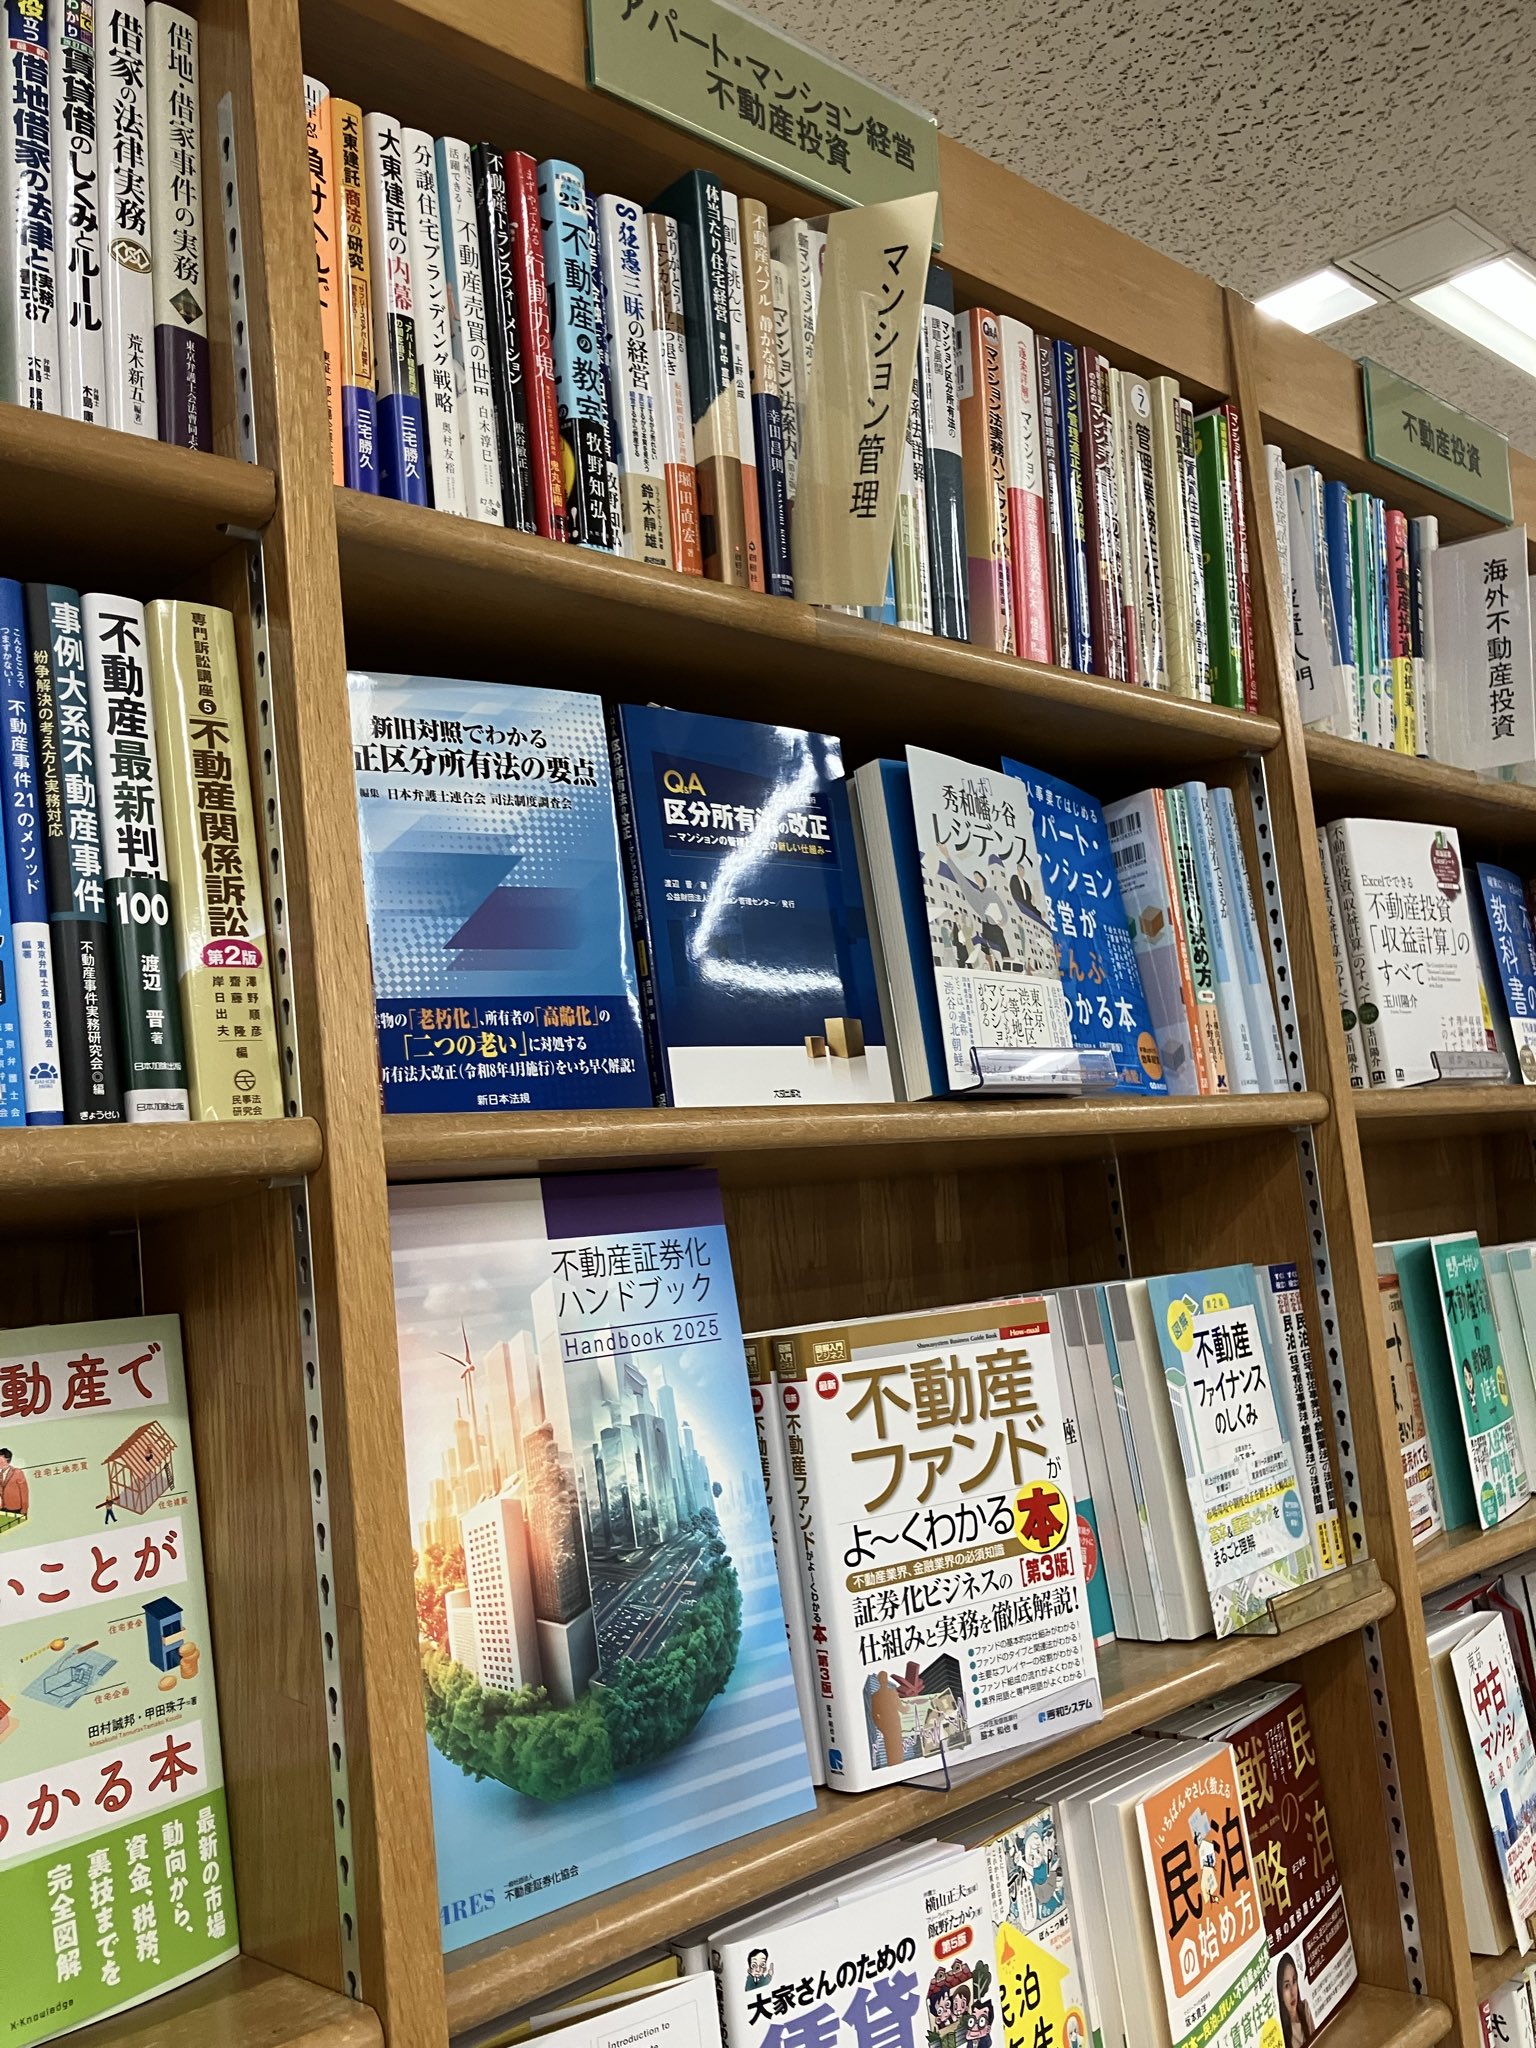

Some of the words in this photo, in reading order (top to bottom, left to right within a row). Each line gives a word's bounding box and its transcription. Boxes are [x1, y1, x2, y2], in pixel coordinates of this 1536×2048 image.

[108, 8, 147, 237] 借家の法律実務
[706, 70, 852, 174] 不動産投資
[12, 52, 56, 272] 借地借家の法律と
[167, 20, 200, 286] 借地・借家事件の実務
[62, 47, 102, 331] 賃貸借のしくみとルール
[378, 128, 412, 311] 大東建託の内幕
[25, 303, 50, 324] 87
[128, 333, 145, 403] 荒木新五
[850, 245, 909, 518] マンション管理
[357, 408, 374, 471] 三宅勝久
[402, 415, 420, 480] 三宅勝久
[1402, 410, 1483, 478] 不動産投資
[678, 471, 696, 544] 堀田直宏
[13, 628, 24, 689] こんなところで
[191, 612, 215, 698] 専門訴訟講座
[1482, 558, 1516, 741] 海外不動産投資
[33, 650, 64, 837] 紛争解決の考え方と実務対応
[50, 601, 106, 914] 事例大系不動産事件
[370, 715, 548, 749] 新旧対照でわかる
[355, 743, 598, 788] 正区分所有法の要点
[8, 699, 40, 896] 不動産事件21のメソッド
[359, 787, 380, 799] 編集
[387, 788, 487, 806] 日本弁護士連合会
[490, 793, 573, 810] 司法制度調査会
[189, 719, 250, 938] 不動産関係訴訟
[932, 812, 1034, 867] レジデンス
[116, 891, 169, 926] 100
[1360, 874, 1414, 889] Excelでできる
[1365, 892, 1452, 923] 不動産投資
[207, 945, 258, 966] 第2版
[1370, 925, 1470, 956] 「収益計算」の
[1490, 894, 1527, 1015] 教科書
[141, 954, 162, 992] 渡辺
[1378, 960, 1424, 986] すべて
[1383, 994, 1418, 1009] 玉川陽介
[145, 1009, 165, 1028] 晋
[150, 1032, 164, 1045] 著
[403, 1031, 588, 1061] 「二つの老い」に対処する
[79, 1110, 121, 1120] ぎょうせい
[232, 1095, 261, 1105] 民事法
[233, 1107, 262, 1117] 研究会
[476, 1092, 531, 1106] 新日本法規
[551, 1237, 712, 1281] 不動産証券化
[558, 1272, 711, 1317] ハンドブック
[565, 1326, 664, 1357] Handbook
[673, 1319, 719, 1341] 2025
[1193, 1320, 1253, 1369] 不動産
[842, 1347, 1038, 1440] 不動産
[1194, 1364, 1266, 1408] ファイナンス
[1062, 1418, 1078, 1445] 座
[1214, 1402, 1259, 1435] のしくみ
[851, 1413, 1047, 1513] ファンド
[1046, 1456, 1062, 1480] が
[1017, 1487, 1064, 1548] 本
[853, 1542, 1006, 1589] 不動産業界、金融業界の必須知識
[1212, 1533, 1257, 1568] まるごと理解
[854, 1569, 1014, 1628] 証券化ビジネスの
[859, 1586, 1081, 1666] 仕組みと実務を徹底解説!
[1480, 1711, 1516, 1761] マンション
[1280, 1792, 1300, 1834] の
[1286, 1703, 1336, 1879] 民泊
[1236, 1735, 1292, 1918] 戦略
[125, 1833, 161, 1965] 資金、税務、
[161, 1818, 194, 1934] 動向から、
[195, 1805, 227, 1940] 最新の市場
[504, 1864, 580, 1902] 不動産証券化協会
[1160, 1806, 1251, 1941] 民泊
[48, 1863, 82, 1983] 完全図解
[87, 1848, 121, 1986] 裏技までを
[941, 1934, 967, 1955] 第5版
[1183, 1889, 1256, 1985] の始め方
[747, 1937, 916, 2026] 大家さんのための
[661, 2021, 671, 2031] to
